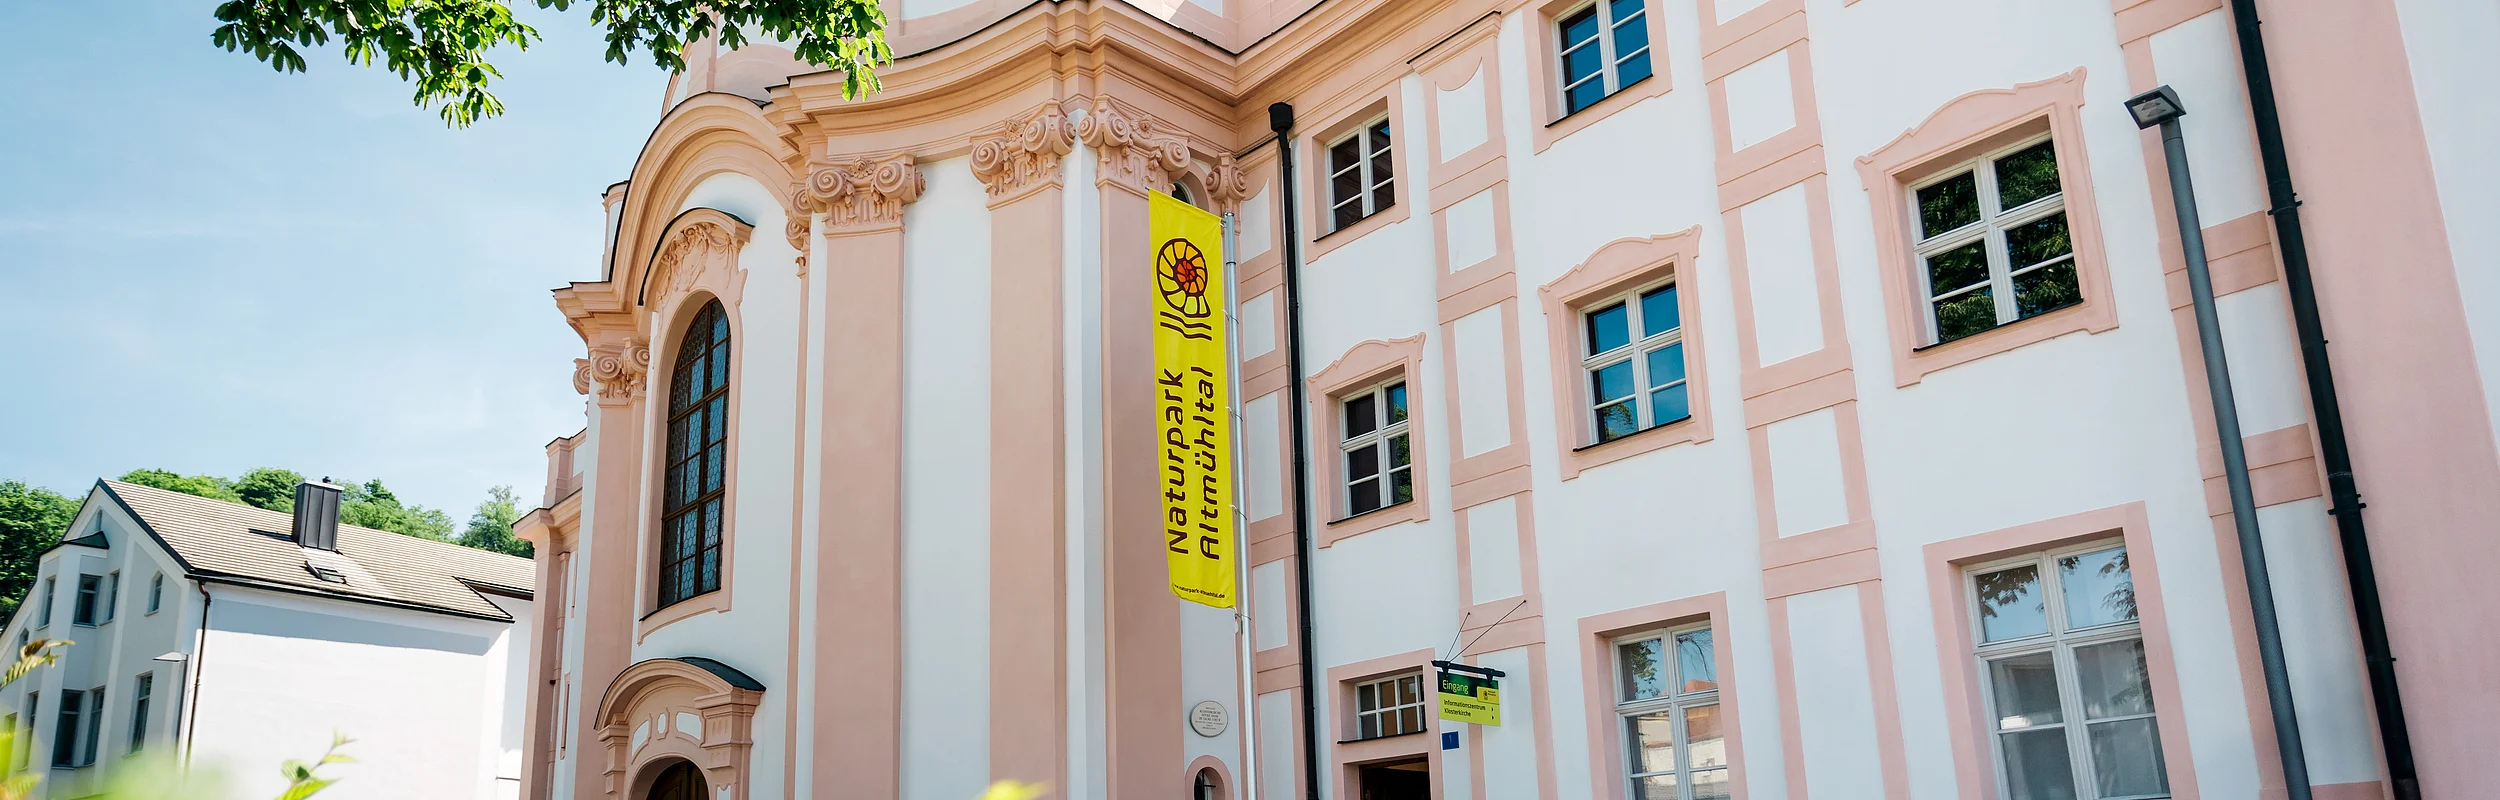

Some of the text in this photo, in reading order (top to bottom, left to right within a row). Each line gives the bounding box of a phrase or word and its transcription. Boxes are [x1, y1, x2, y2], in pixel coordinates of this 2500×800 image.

[1158, 368, 1190, 555] Naturpark
[1190, 366, 1220, 560] Altmühltal
[1442, 680, 1469, 695] Eingang
[1443, 699, 1486, 711] Informationszentrum
[1444, 708, 1471, 717] Klosterkirche
